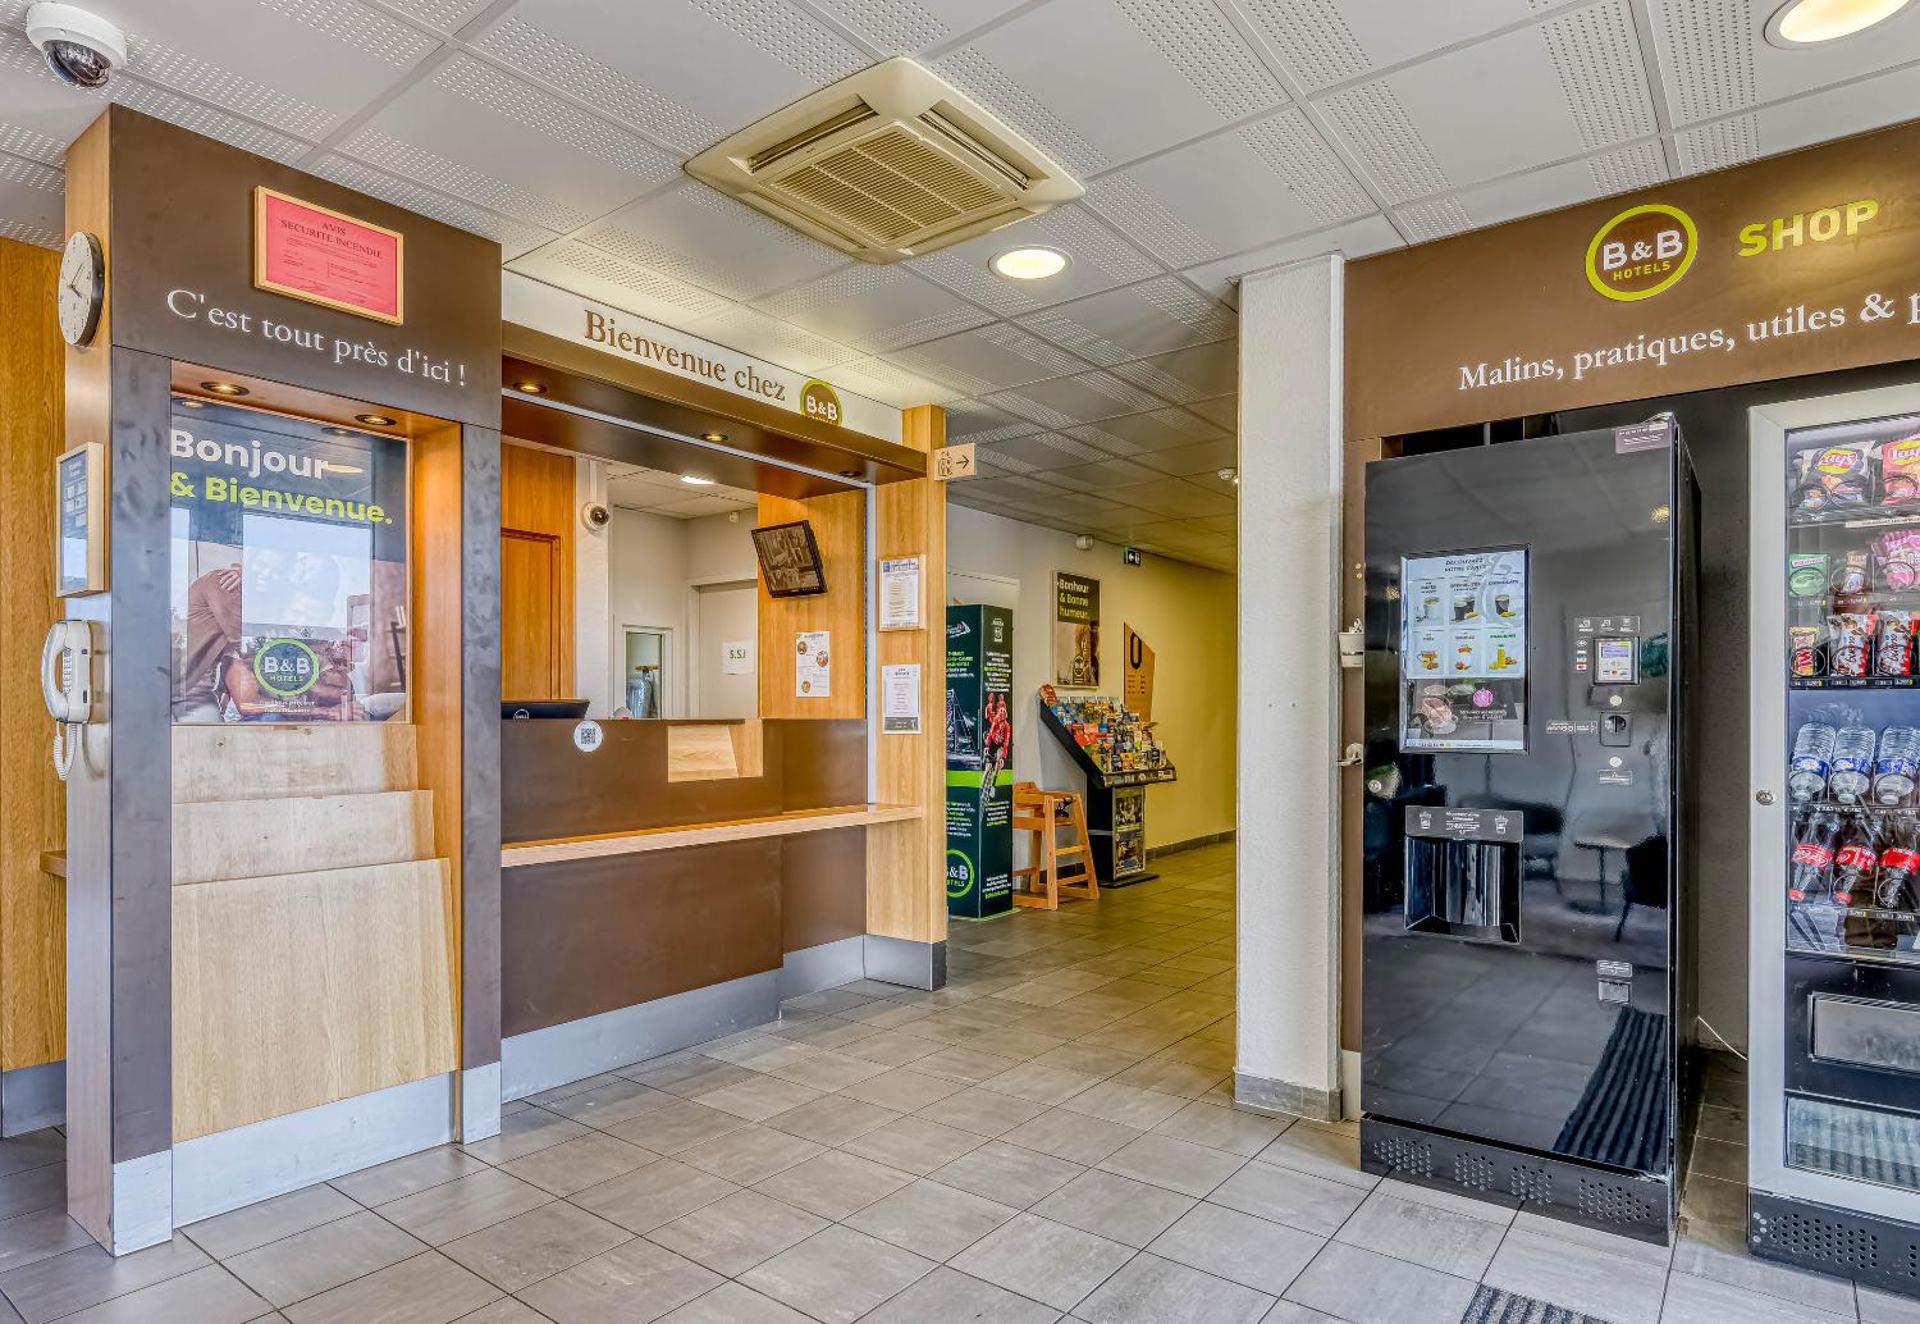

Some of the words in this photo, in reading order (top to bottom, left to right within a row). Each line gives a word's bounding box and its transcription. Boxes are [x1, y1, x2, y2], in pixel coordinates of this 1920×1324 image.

[321, 222, 346, 236] AVIS
[1737, 199, 1880, 258] SHOP
[1602, 229, 1683, 271] B&B
[1612, 260, 1672, 281] HOTELS
[166, 289, 250, 333] C'est
[261, 319, 325, 351] tout
[334, 331, 389, 369] près
[397, 348, 451, 384] d'ici
[1458, 356, 1565, 391] Malins,
[1573, 327, 1736, 381] pratiques,
[1746, 303, 1846, 342] utiles
[1860, 293, 1896, 322] &
[583, 309, 727, 383] Bienvenue
[734, 366, 786, 401] chez
[806, 395, 838, 421] B&B
[170, 429, 329, 479] Bonjour
[169, 471, 197, 499] &
[205, 477, 393, 525] Bienvenue.
[1060, 579, 1090, 594] Bonheur
[1060, 593, 1066, 604] &
[264, 656, 311, 674] B&B
[271, 674, 304, 682] HOTELS
